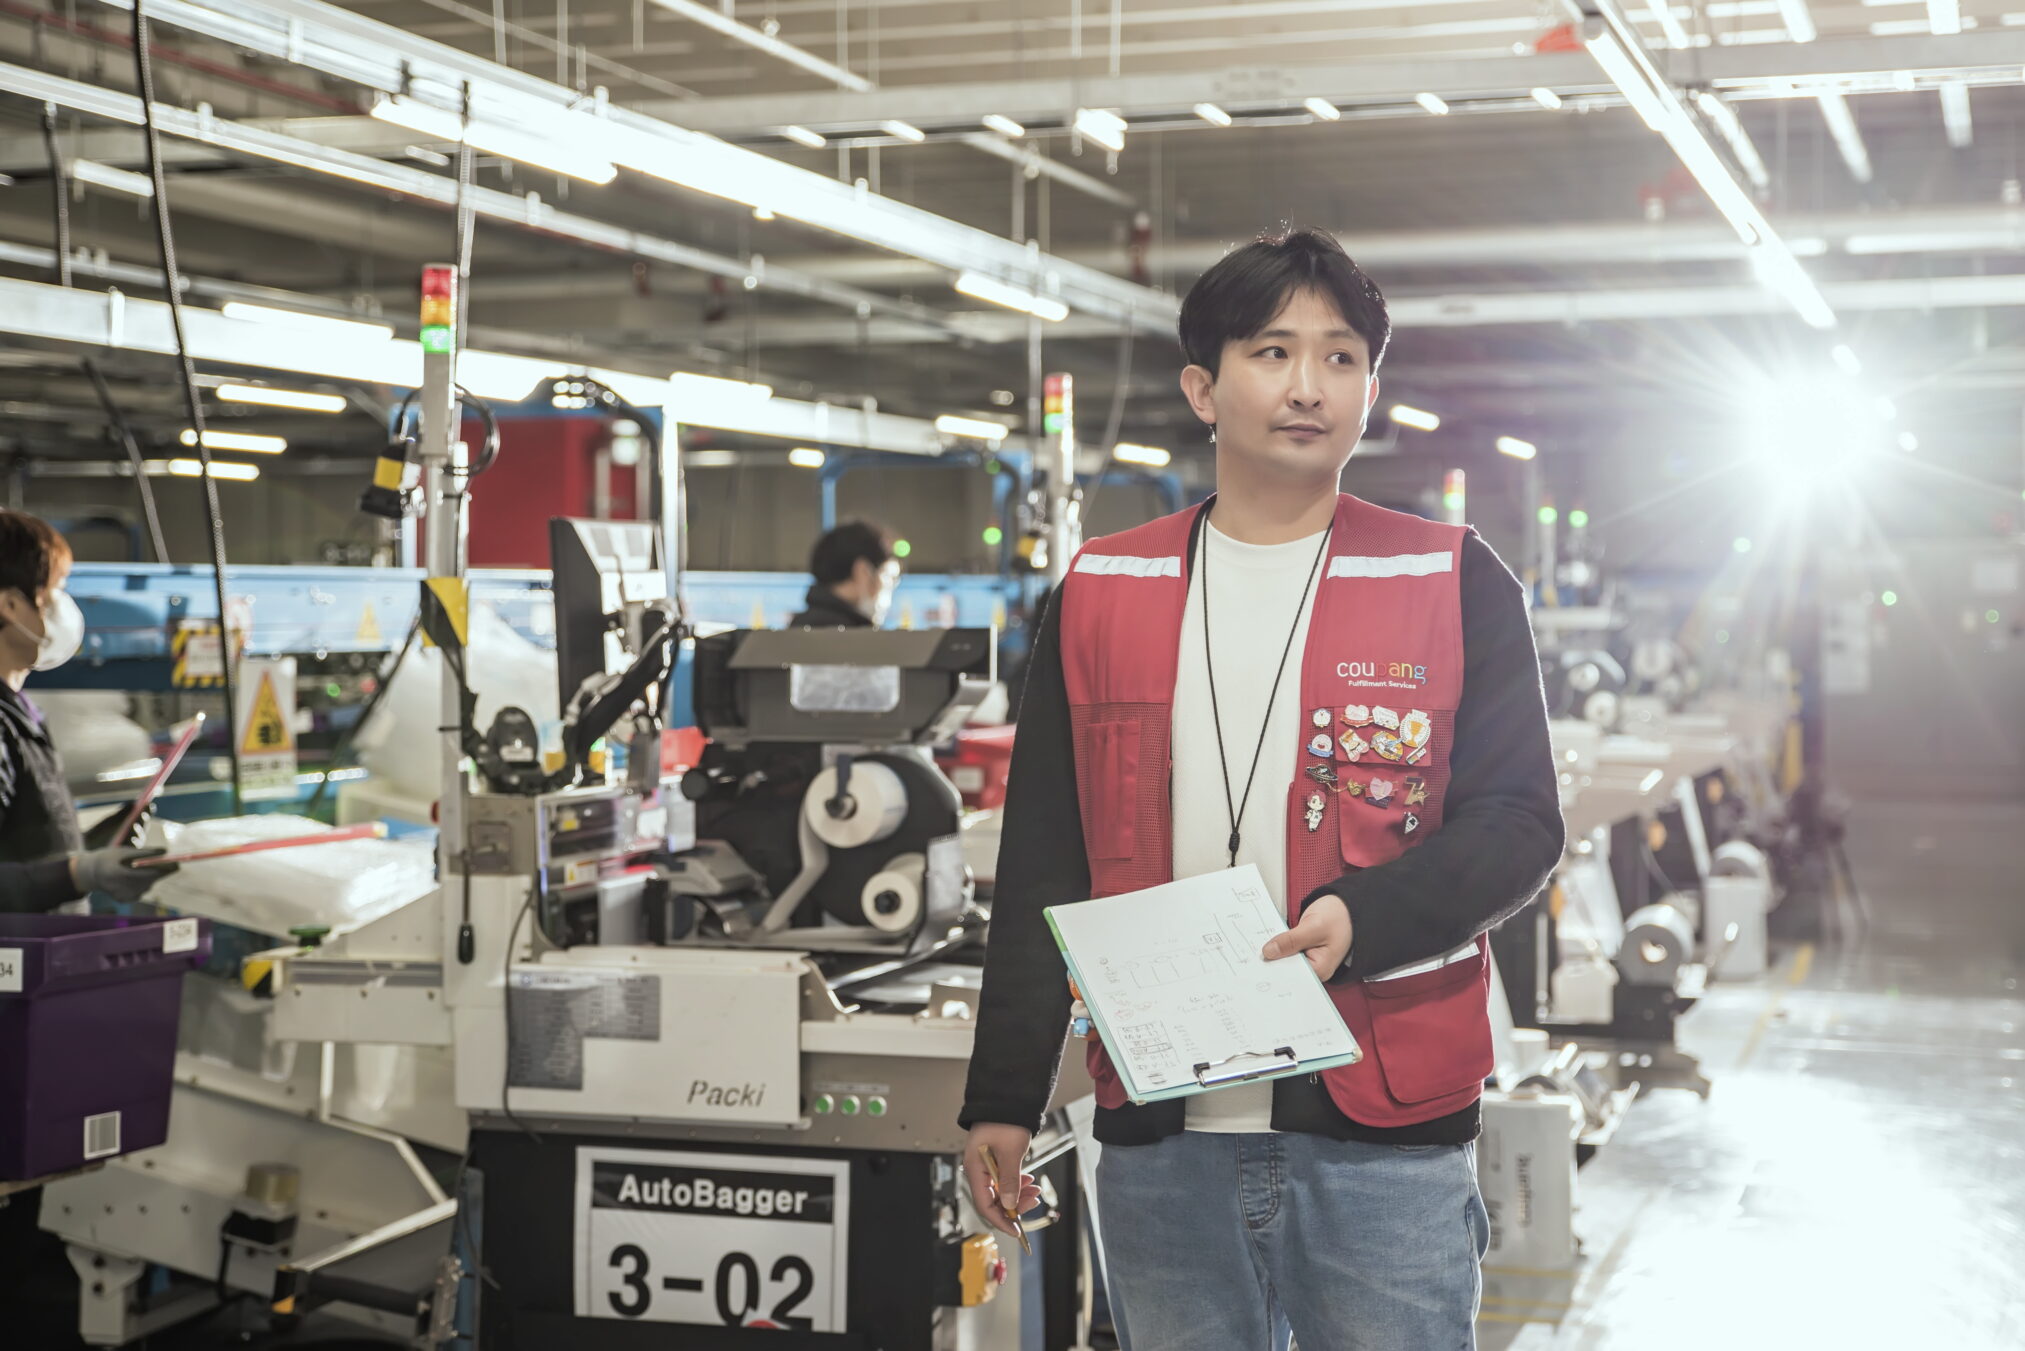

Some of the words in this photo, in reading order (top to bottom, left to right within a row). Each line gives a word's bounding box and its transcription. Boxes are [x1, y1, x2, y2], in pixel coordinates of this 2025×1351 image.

[1336, 661, 1427, 685] coupang
[1348, 680, 1388, 688] Fulfillment
[1388, 680, 1417, 690] Services
[686, 1079, 767, 1108] Packi
[617, 1173, 809, 1216] AutoBagger
[607, 1242, 815, 1333] 3-02
